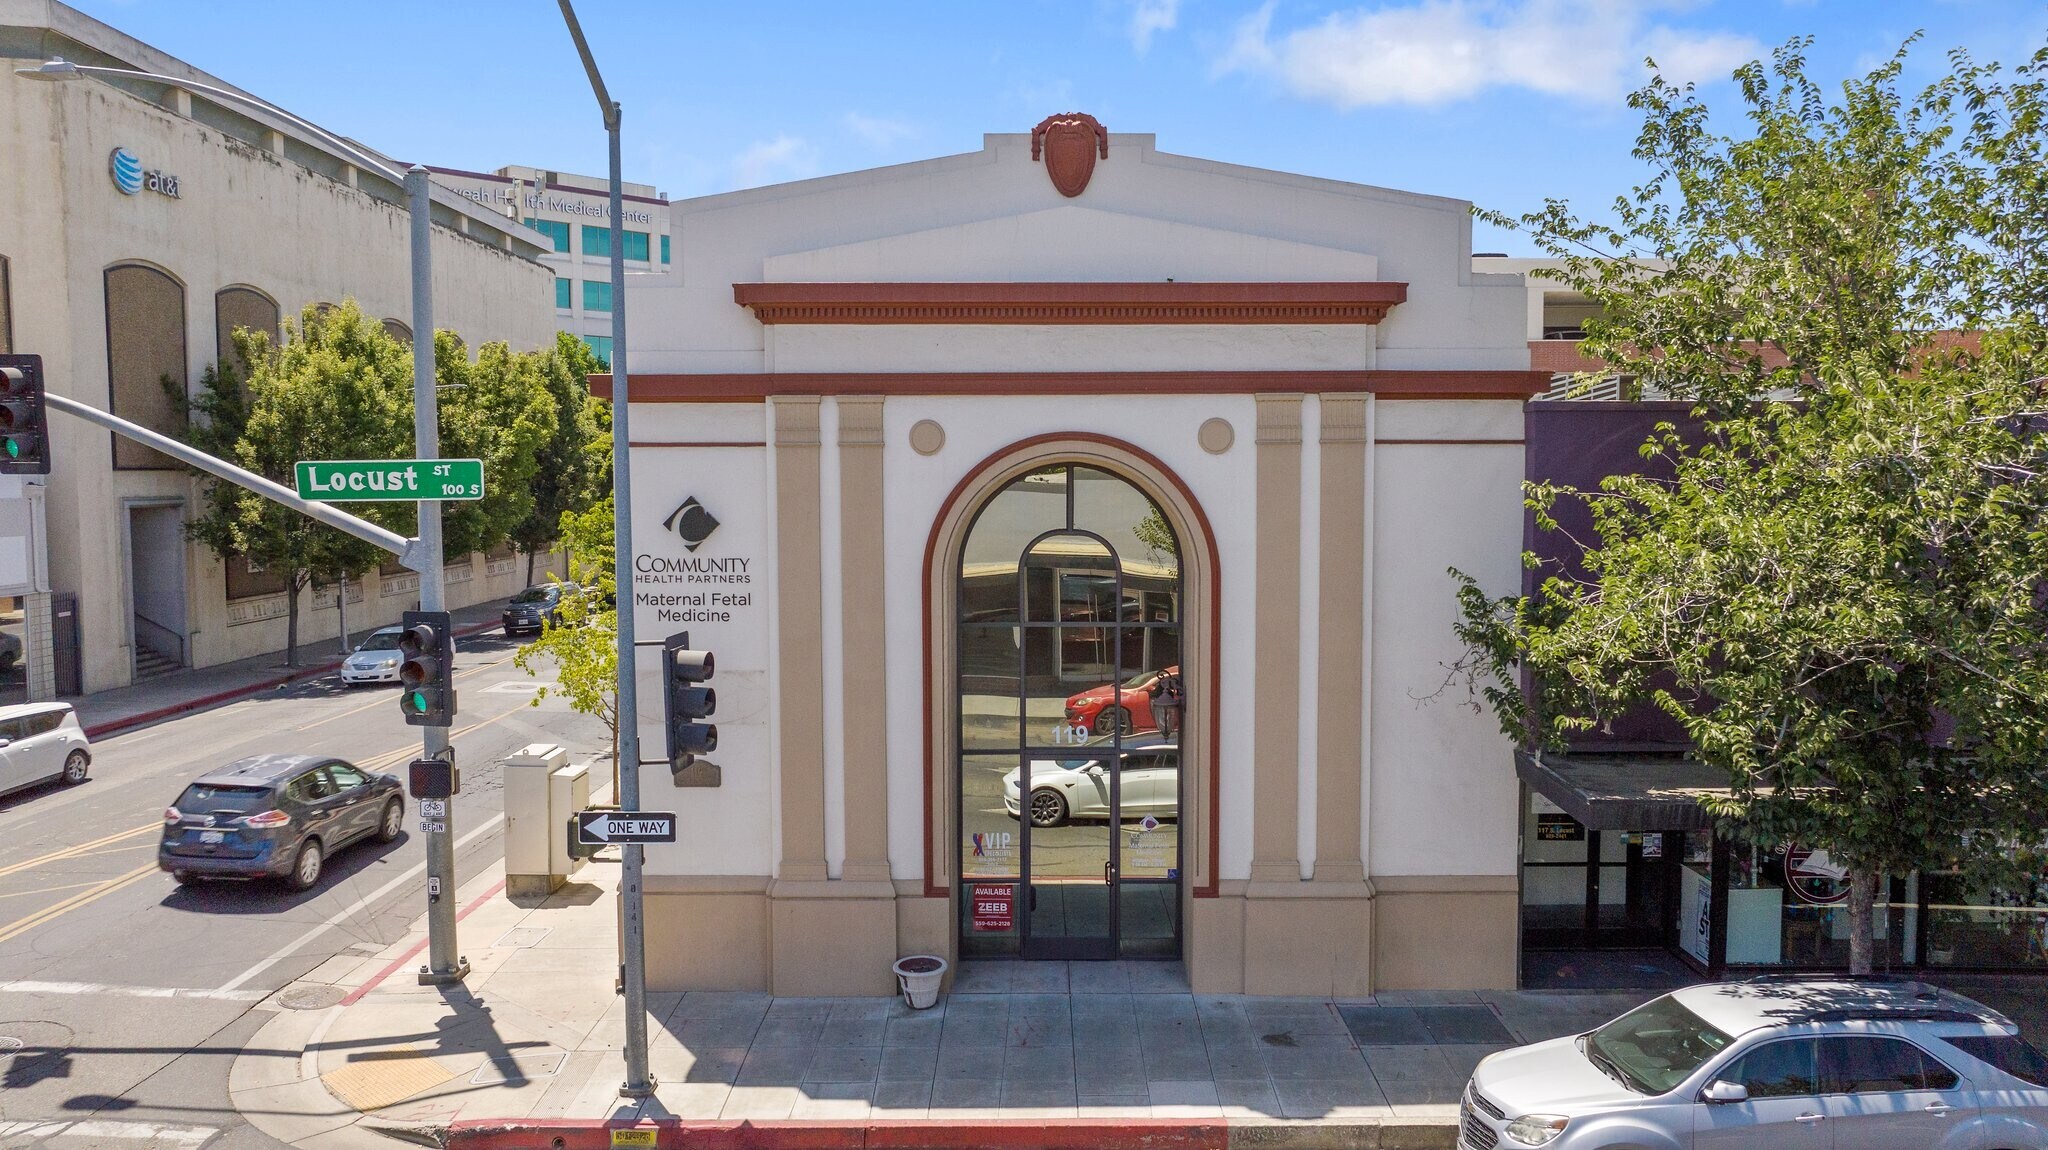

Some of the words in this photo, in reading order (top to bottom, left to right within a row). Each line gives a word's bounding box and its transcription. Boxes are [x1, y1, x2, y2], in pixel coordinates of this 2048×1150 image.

[148, 169, 182, 200] at&t
[495, 188, 545, 210] Hlth
[550, 196, 604, 218] Medical
[607, 206, 653, 223] enter
[308, 466, 418, 492] Locust
[432, 464, 452, 477] ST
[441, 483, 465, 495] 100
[468, 484, 480, 495] S
[635, 554, 750, 573] COMMUNITY
[635, 574, 683, 584] HEALTH
[687, 574, 751, 584] PARTNERS
[636, 592, 706, 606] Maternal
[711, 592, 751, 606] Fetal
[658, 608, 731, 622] Medicine
[1051, 725, 1089, 744] 119
[422, 823, 444, 832] BEGIN
[608, 821, 634, 834] ONE
[638, 821, 666, 834] WAY
[985, 832, 1011, 849] VIP
[975, 888, 1011, 896] AVAILABLE
[978, 902, 1008, 912] ZEEB
